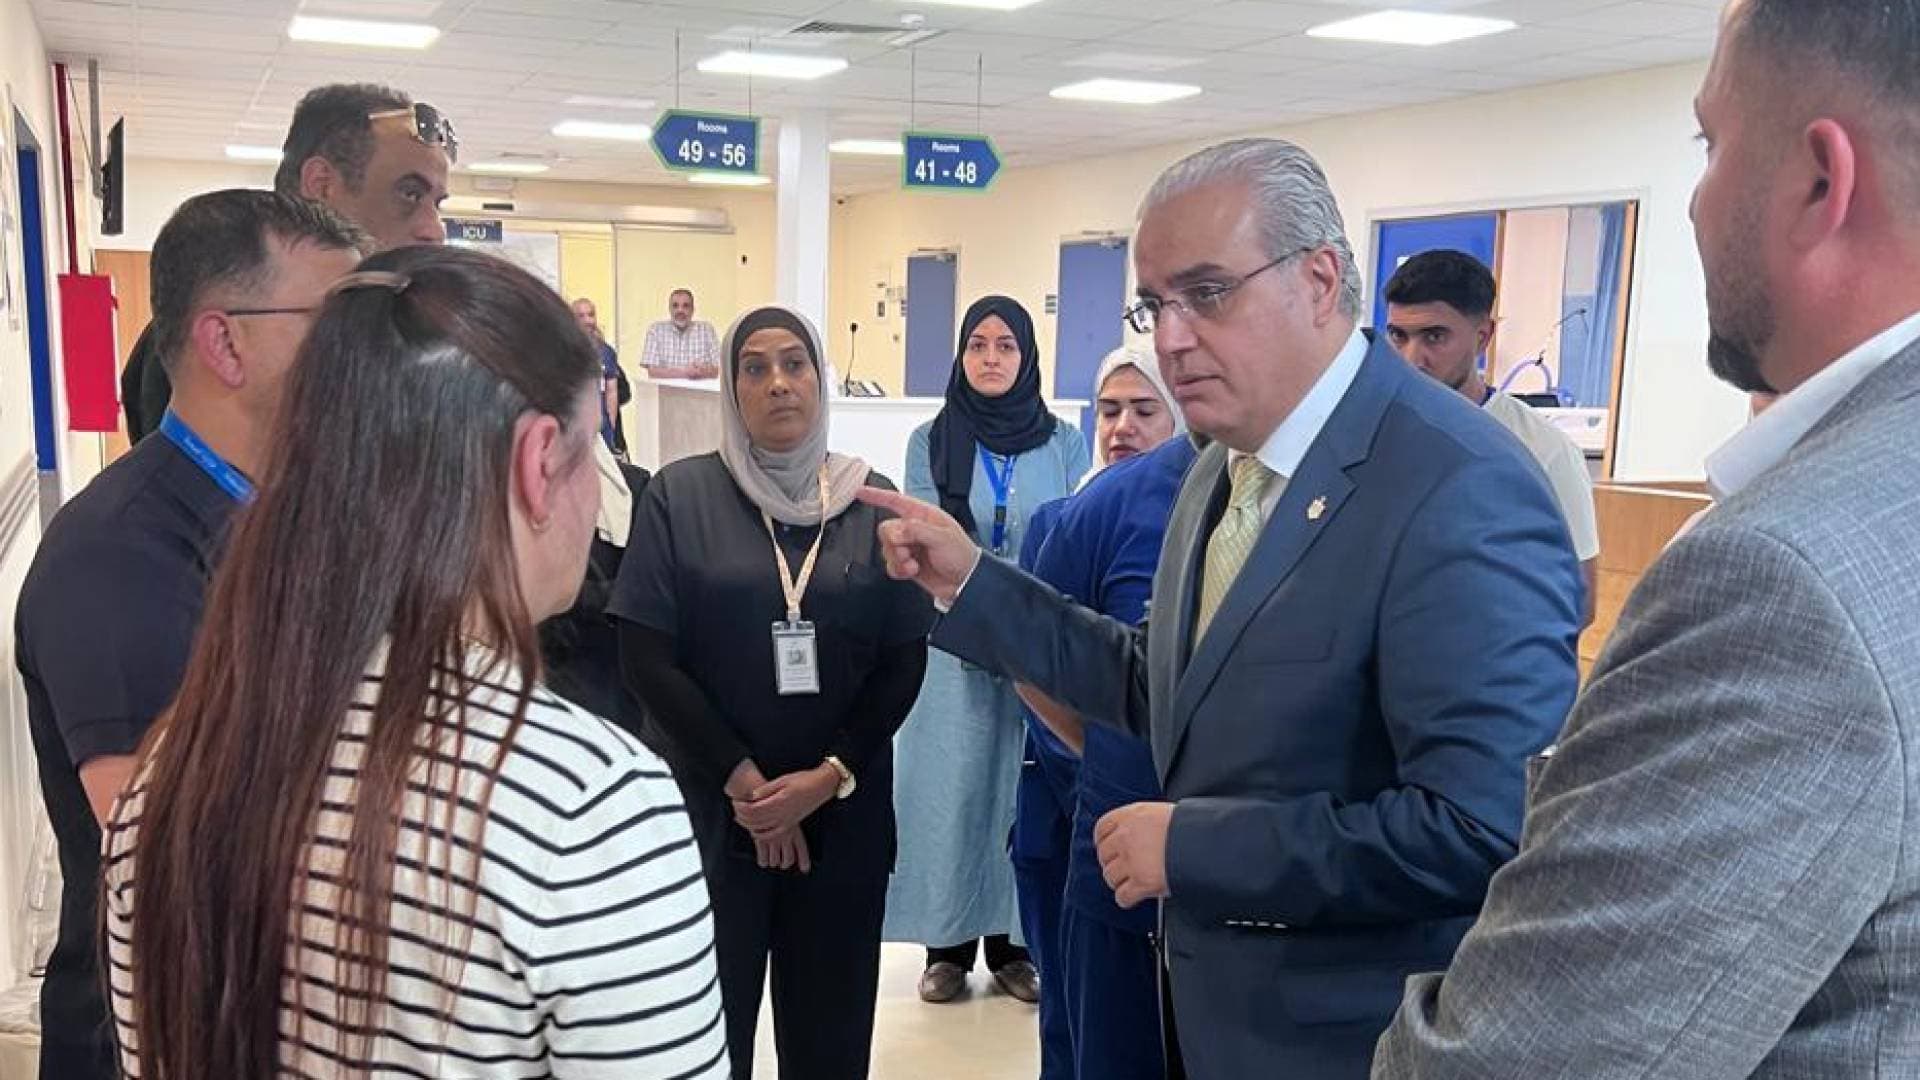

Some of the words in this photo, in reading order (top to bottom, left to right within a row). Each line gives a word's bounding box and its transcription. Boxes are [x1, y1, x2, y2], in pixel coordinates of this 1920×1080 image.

[697, 120, 728, 134] Rooms
[679, 138, 703, 163] 49
[722, 143, 746, 167] 56
[932, 141, 960, 153] Rooms
[915, 158, 935, 182] 41
[954, 159, 977, 184] 48
[462, 225, 487, 240] ICU
